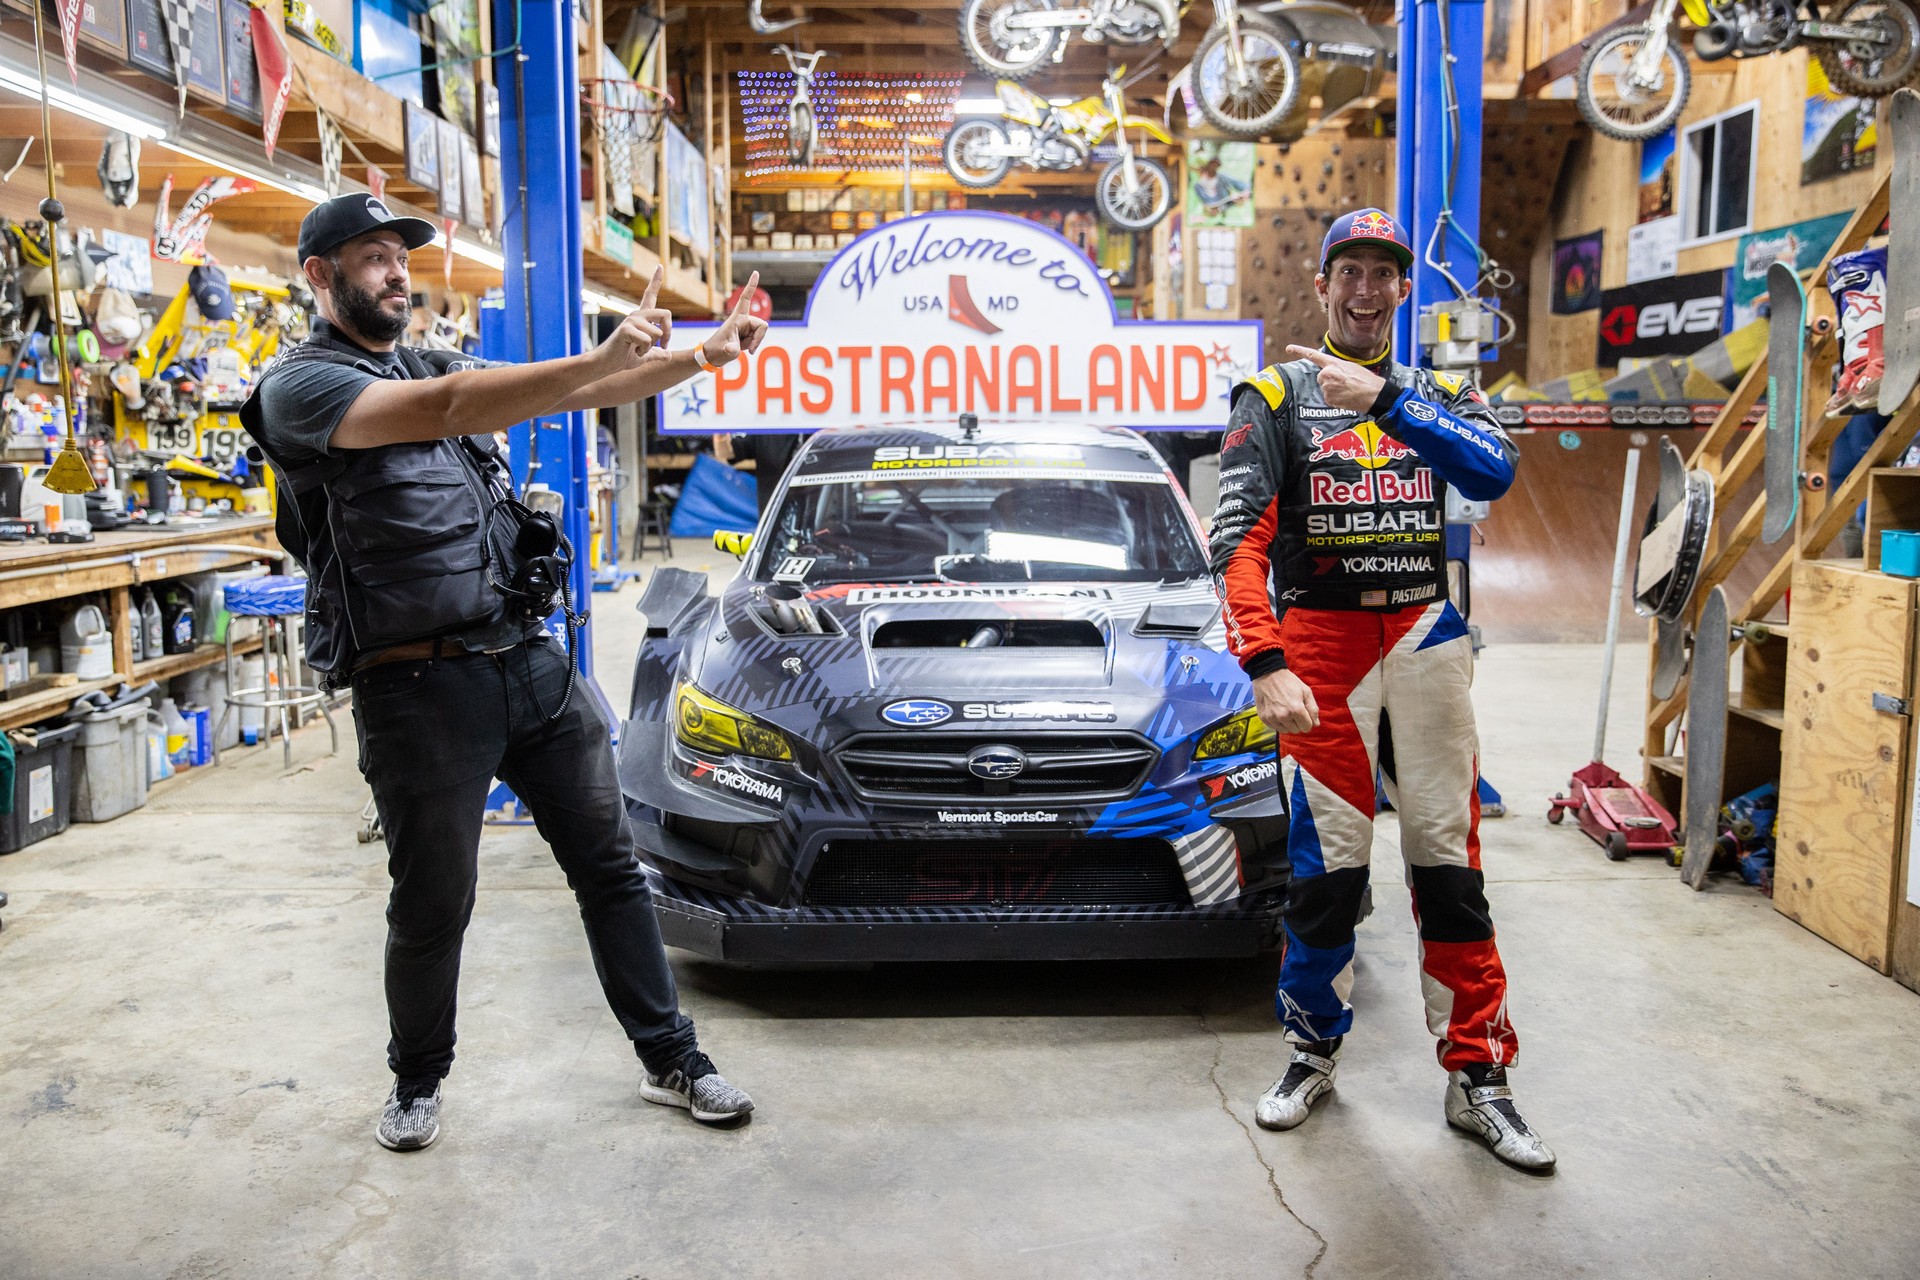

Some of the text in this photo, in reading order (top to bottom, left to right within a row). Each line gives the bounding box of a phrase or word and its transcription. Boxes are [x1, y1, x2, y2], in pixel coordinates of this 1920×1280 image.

[1351, 226, 1396, 241] Red Bull
[840, 223, 1090, 301] Welcome to
[903, 295, 1019, 311] USA MD
[714, 345, 1209, 414] PASTRANALAND
[1437, 417, 1503, 460] SUBARU
[872, 459, 1036, 470] MOTORSPORTS
[1310, 467, 1434, 506] Red Bull
[1307, 510, 1441, 534] SUBARU
[1306, 533, 1440, 546] MOTORSPORTS USA
[1341, 556, 1433, 573] YOKOHAMA
[1391, 583, 1437, 604] PASTRANA
[712, 767, 783, 802] YOKOHAMA
[1226, 761, 1278, 789] YOKOHA
[937, 810, 1058, 824] Vermont SportsCar
